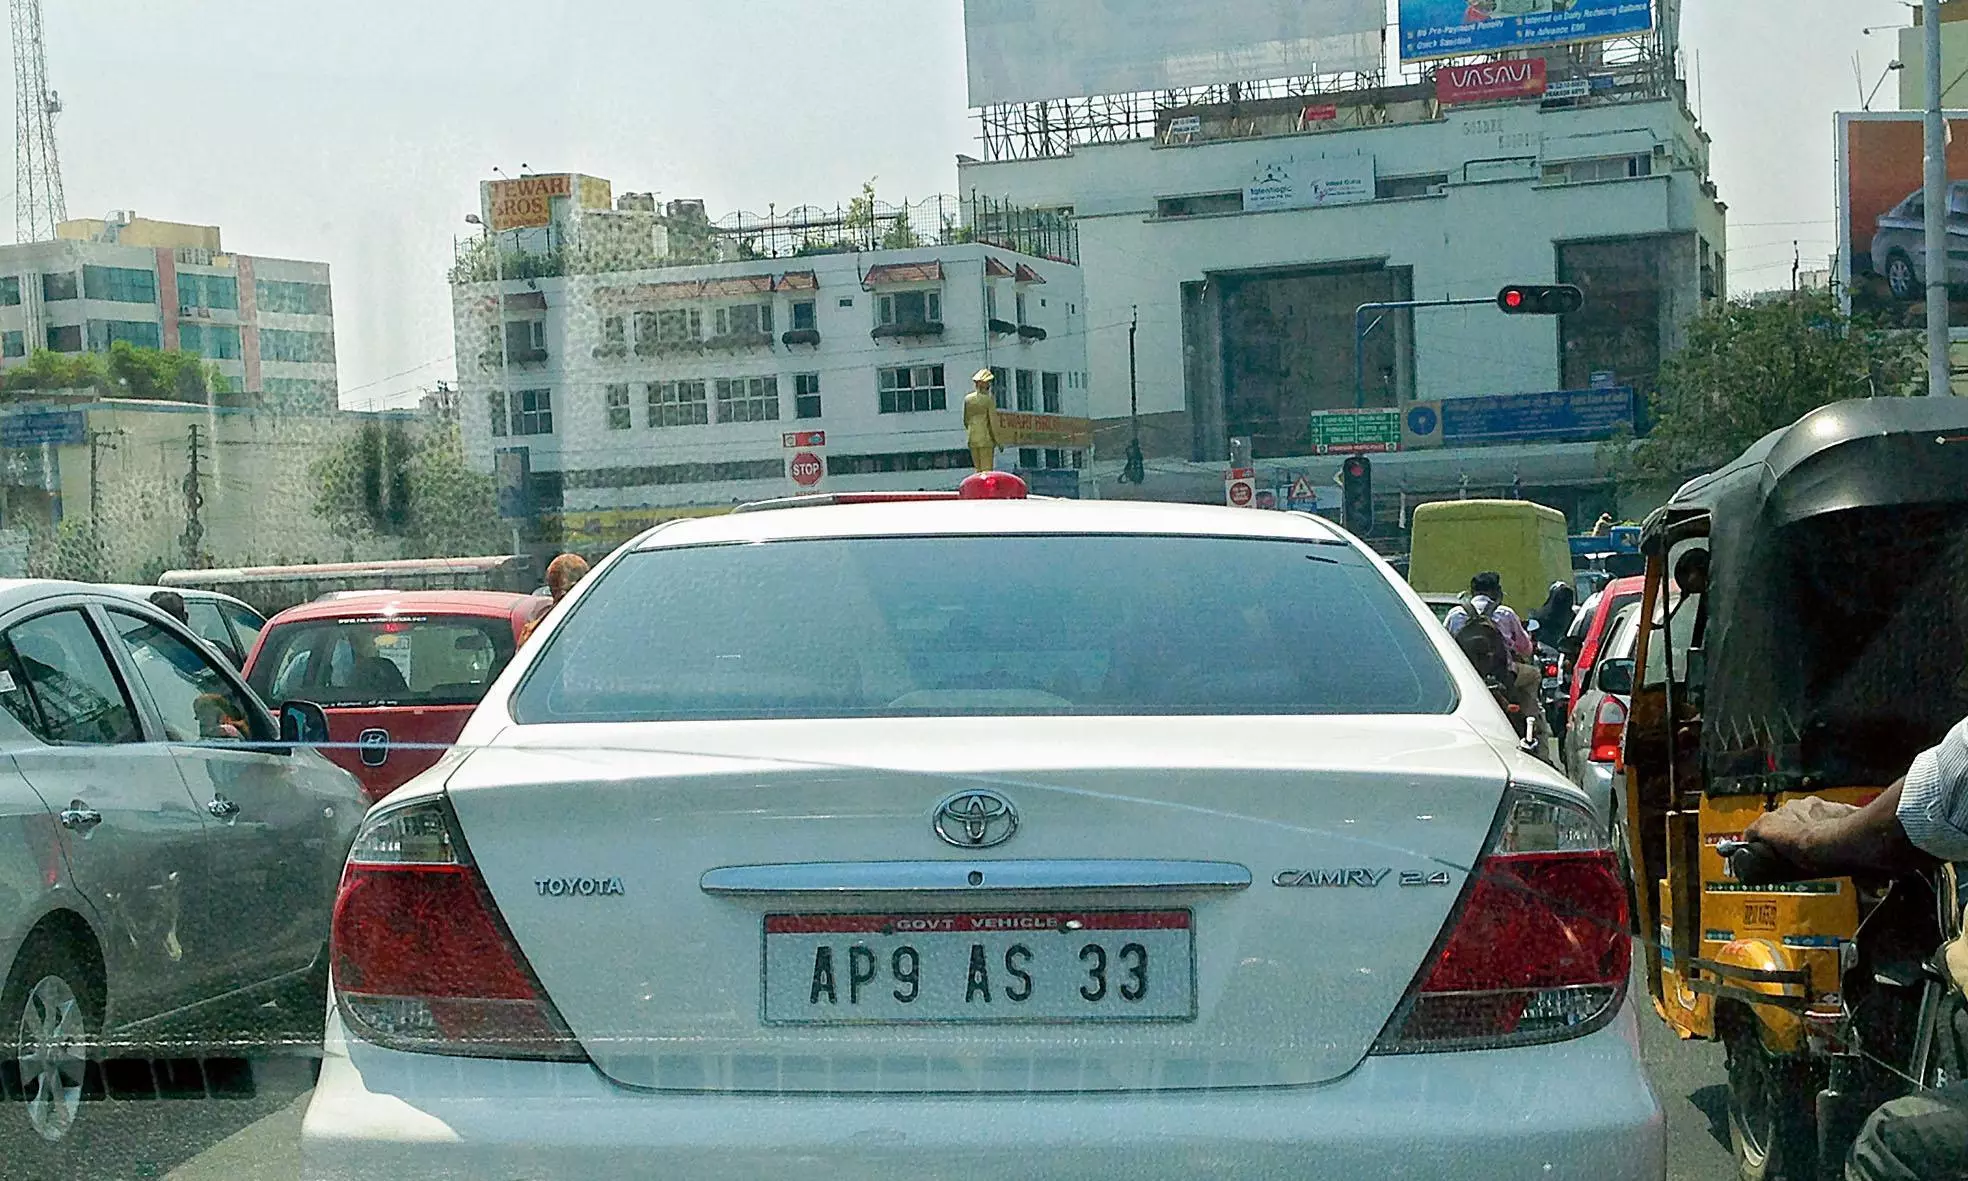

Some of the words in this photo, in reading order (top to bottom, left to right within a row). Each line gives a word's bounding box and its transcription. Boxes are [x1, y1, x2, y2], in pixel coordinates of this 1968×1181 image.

[1428, 23, 1476, 36] Pre-Payment
[1536, 26, 1569, 36] Advance
[1451, 63, 1531, 88] VASAVI
[793, 462, 820, 476] STOP
[1272, 867, 1392, 888] CAMRY
[534, 877, 625, 896] TOYOTA
[897, 918, 954, 930] GOVT
[970, 917, 1060, 929] VEHICLE
[964, 943, 1034, 1003] AS
[1078, 942, 1149, 1002] 33
